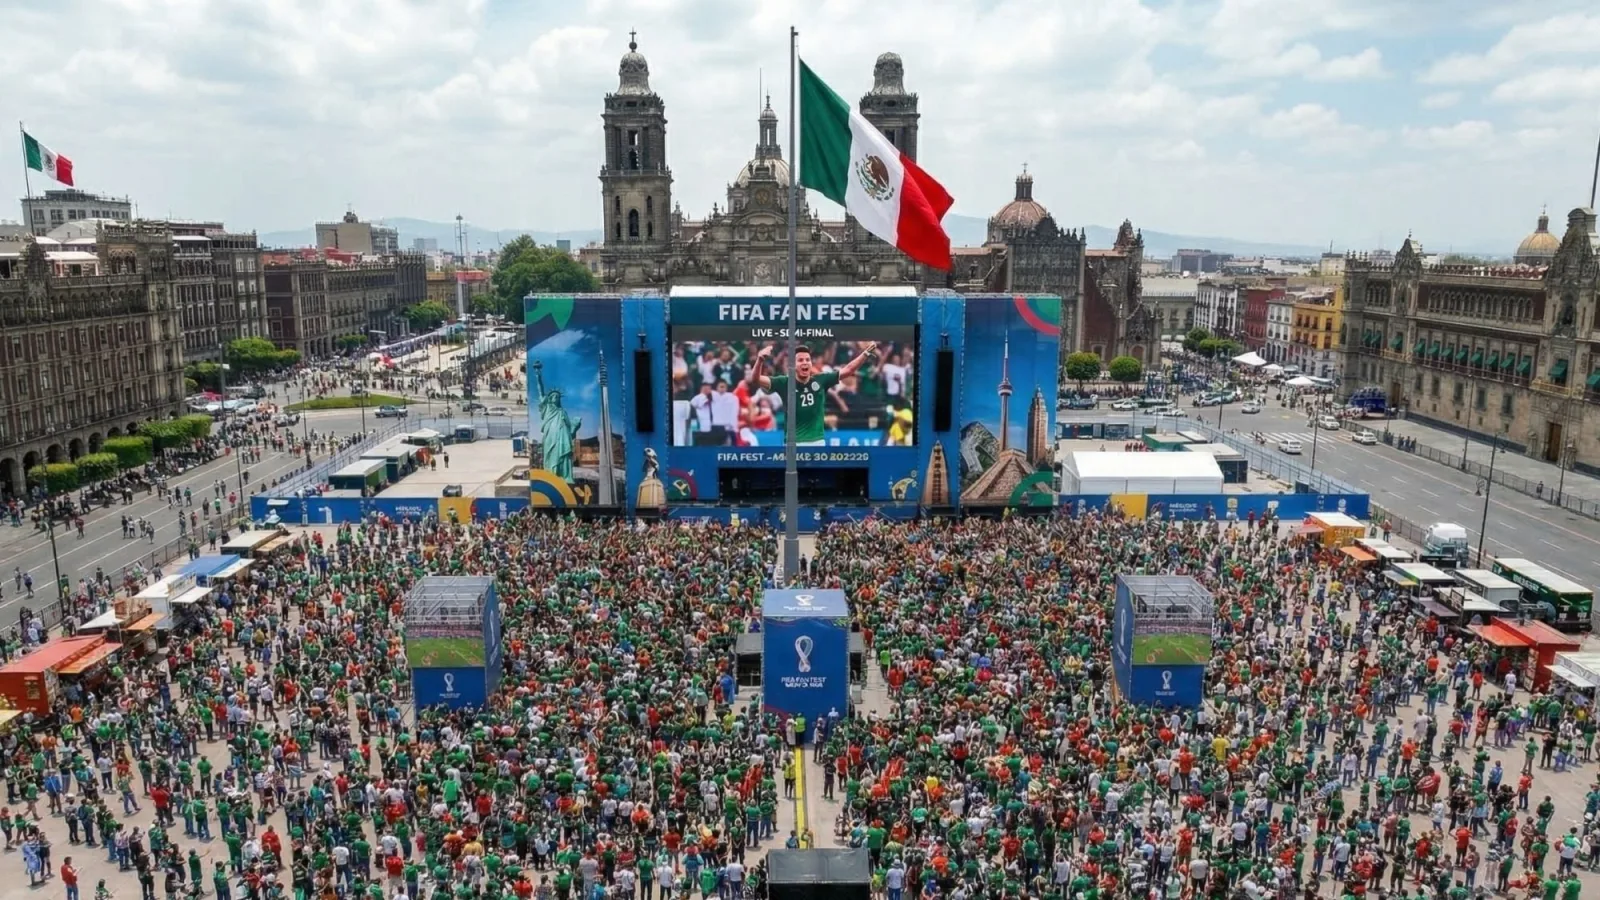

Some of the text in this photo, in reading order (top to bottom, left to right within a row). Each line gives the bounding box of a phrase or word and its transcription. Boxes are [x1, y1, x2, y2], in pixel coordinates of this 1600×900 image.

[719, 304, 869, 321] FIFA FAN FEST
[752, 328, 773, 338] LIVE
[800, 393, 814, 407] 29
[717, 452, 739, 462] FIFA
[740, 452, 765, 462] FEST
